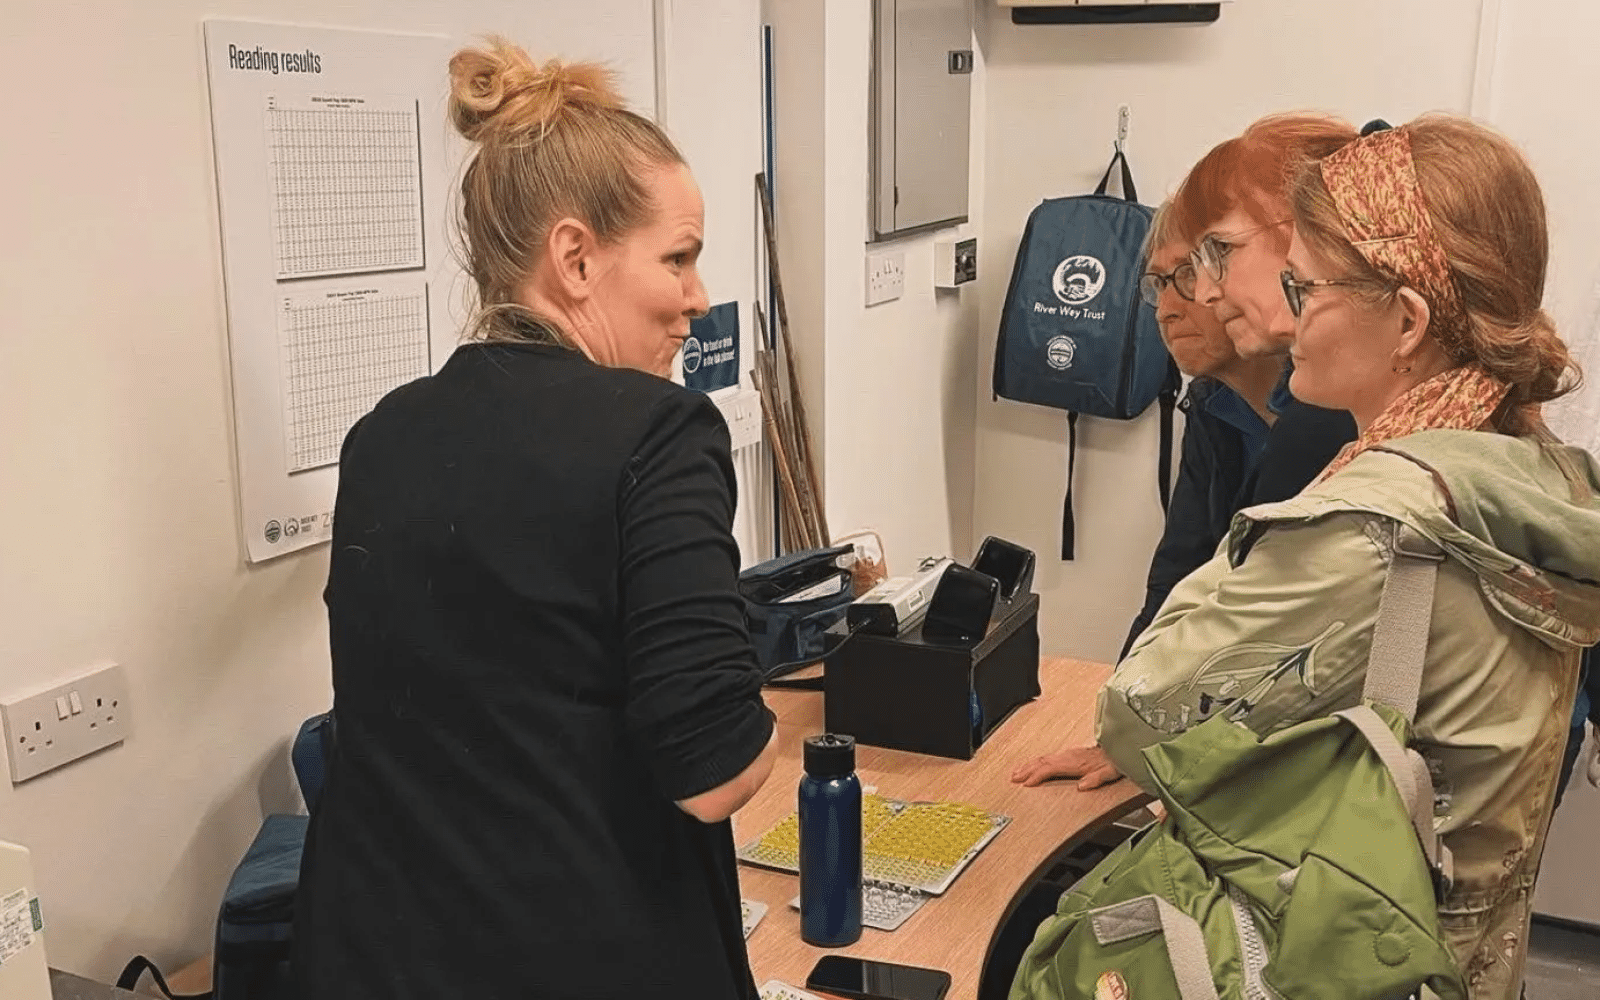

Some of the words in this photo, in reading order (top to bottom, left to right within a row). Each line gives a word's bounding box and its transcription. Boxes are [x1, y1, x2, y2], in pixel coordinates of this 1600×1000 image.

[228, 44, 279, 75] Reading
[281, 49, 321, 73] results
[1034, 301, 1058, 315] River
[1082, 308, 1105, 320] Trust
